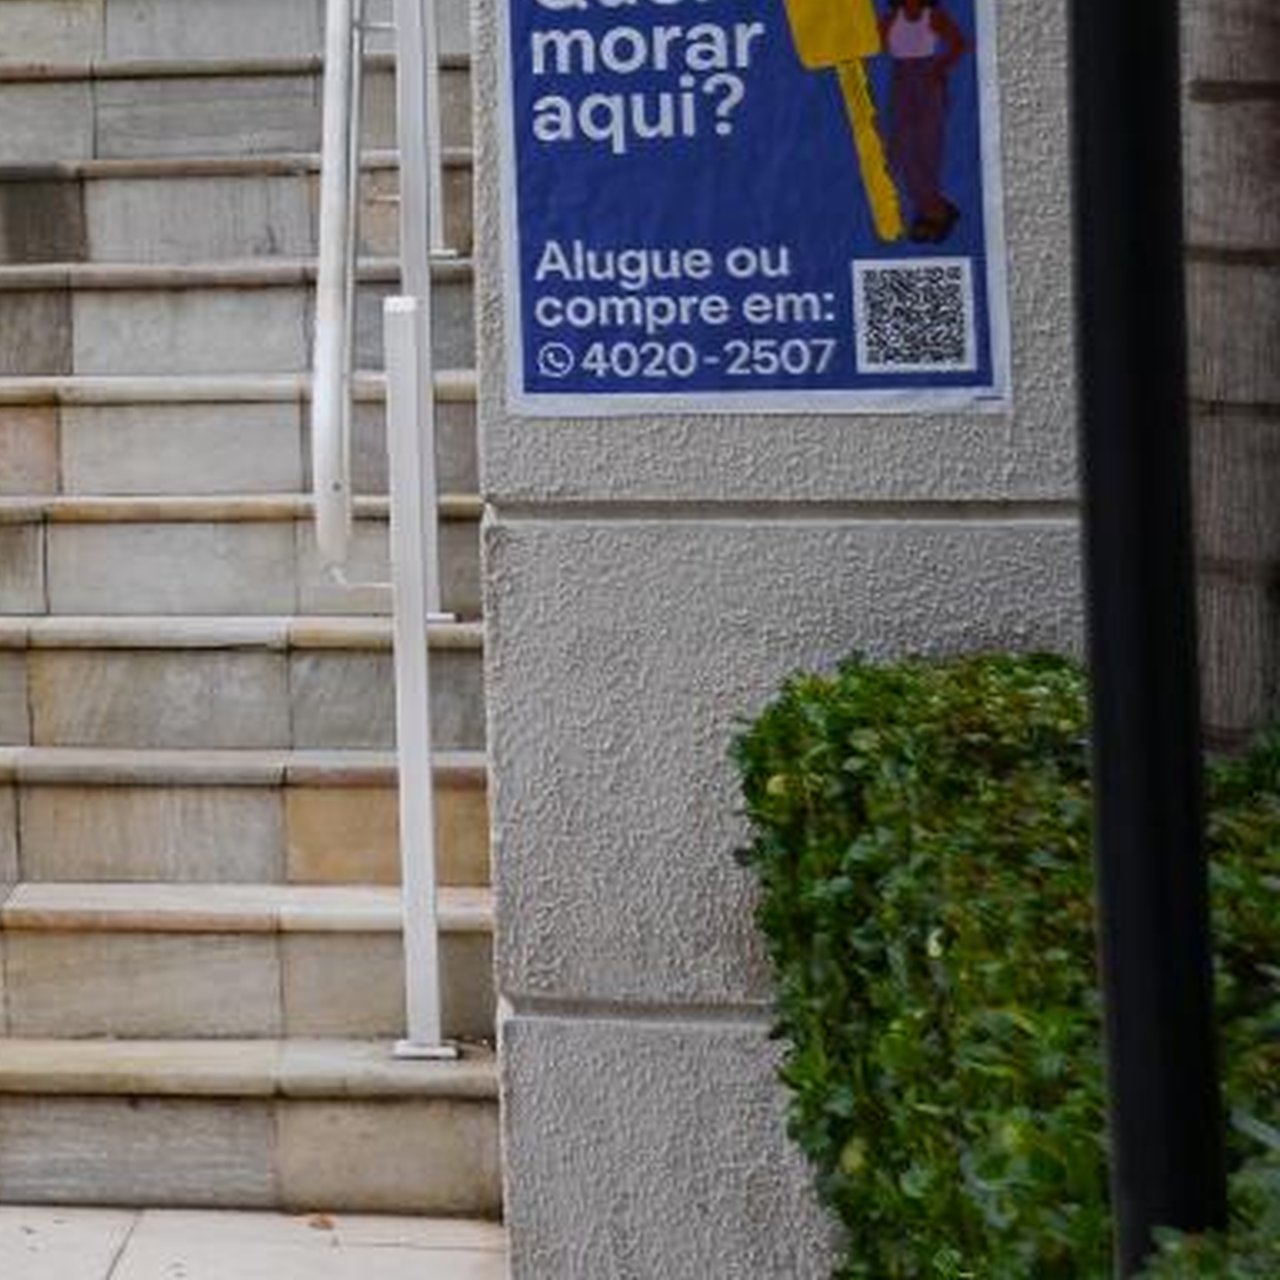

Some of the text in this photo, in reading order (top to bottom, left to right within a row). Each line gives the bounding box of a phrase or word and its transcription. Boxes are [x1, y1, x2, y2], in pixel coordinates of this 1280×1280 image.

[531, 22, 766, 75] morar
[532, 72, 745, 155] aqui?
[534, 238, 789, 291] Alugue ou
[534, 292, 835, 335] compre em:
